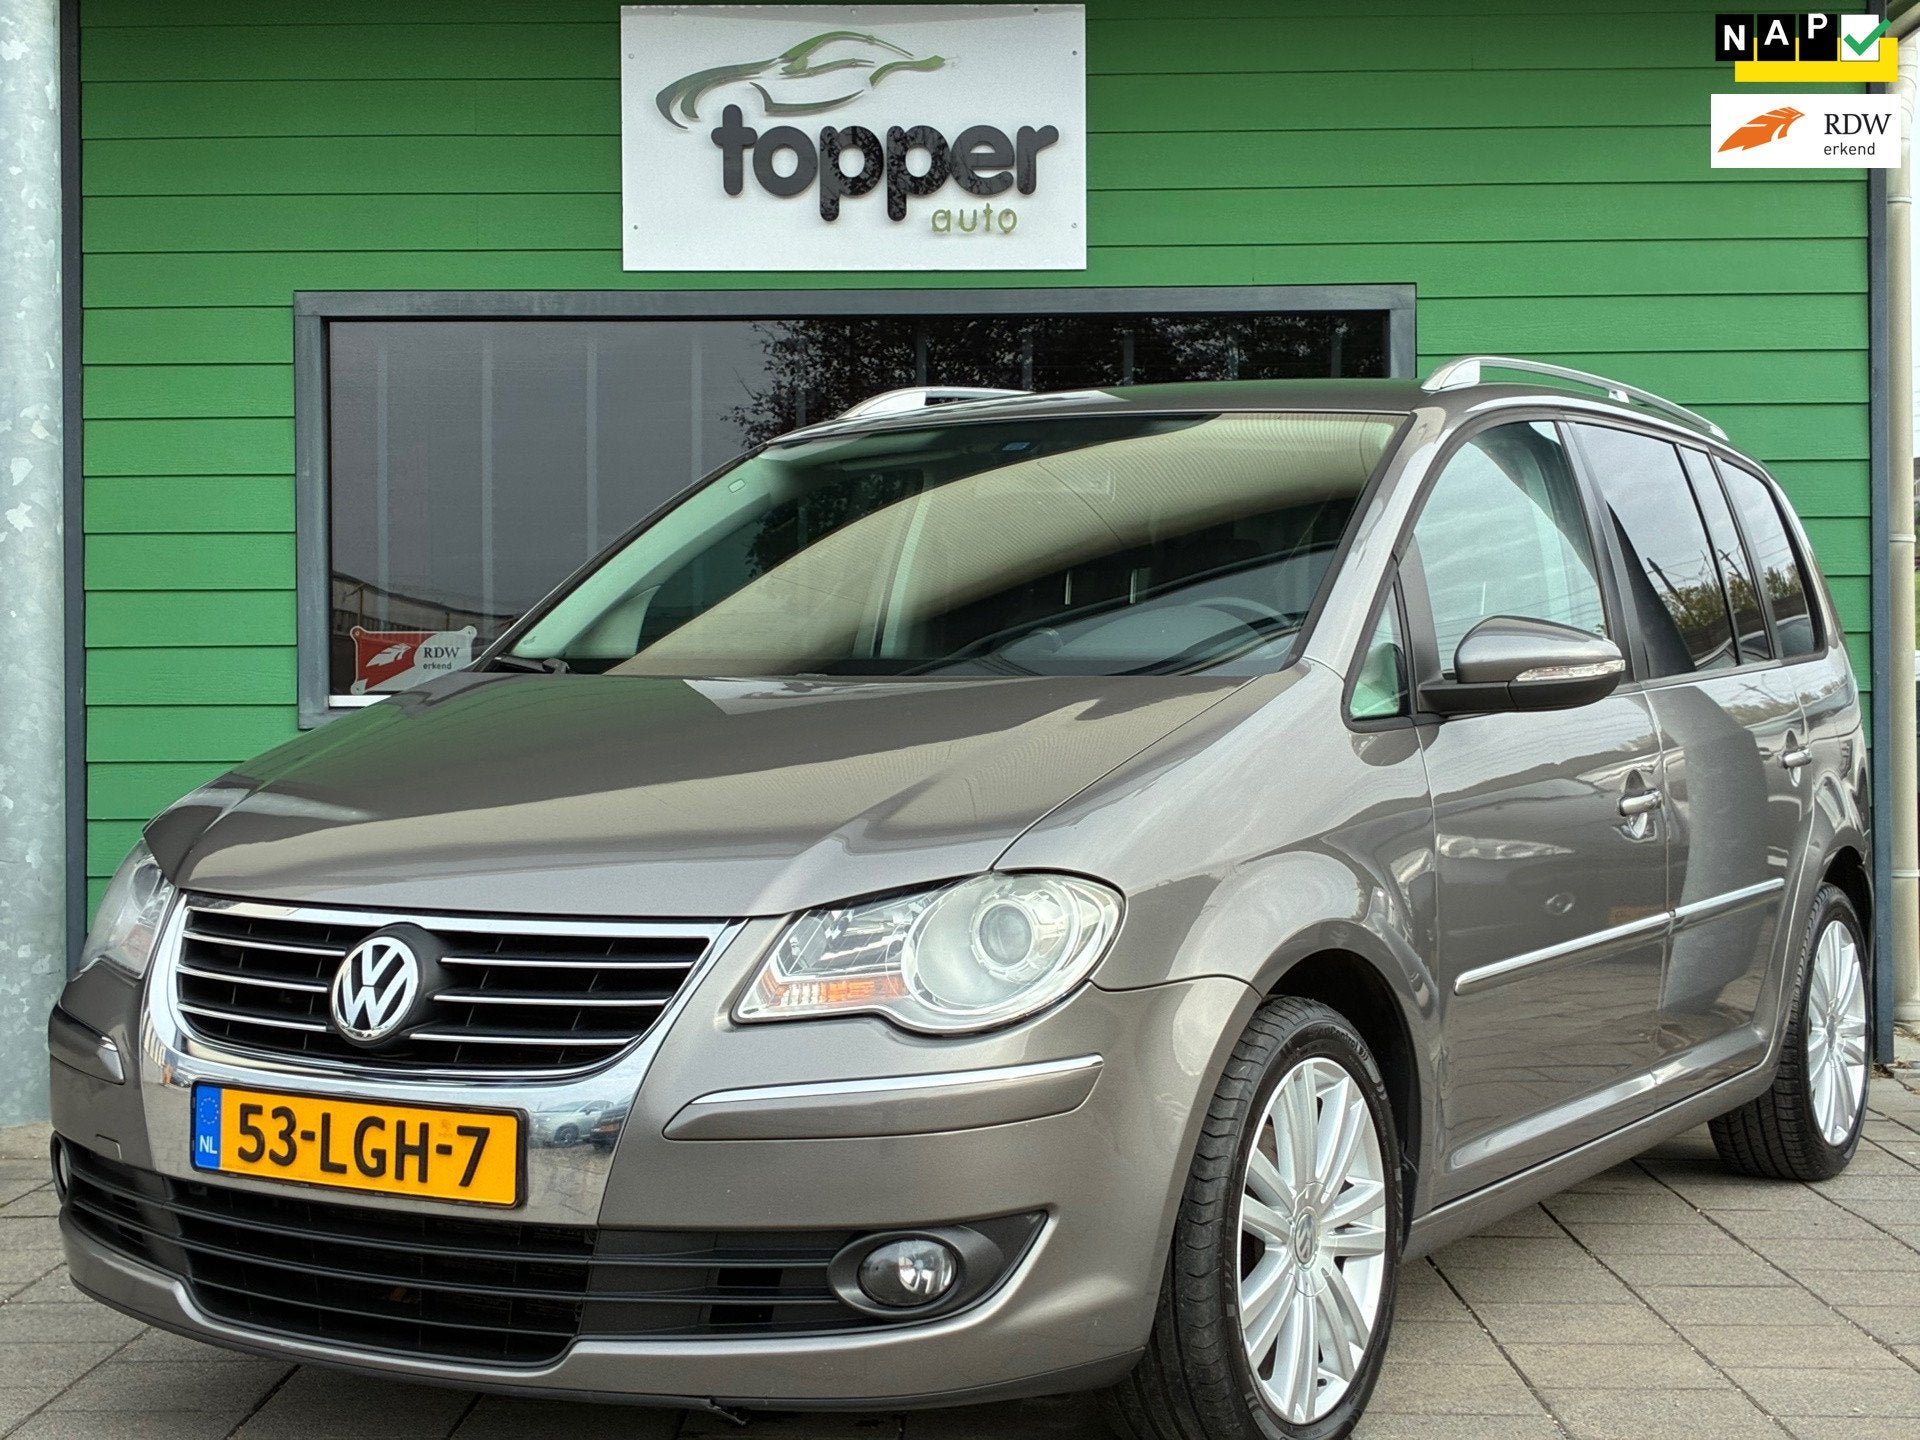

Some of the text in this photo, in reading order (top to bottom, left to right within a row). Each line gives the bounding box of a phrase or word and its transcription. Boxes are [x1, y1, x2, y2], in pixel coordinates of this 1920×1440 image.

[711, 104, 1059, 221] topper
[931, 203, 1018, 233] auto
[423, 647, 460, 659] RDW
[423, 661, 452, 670] erkend
[199, 1135, 218, 1155] NL
[237, 1103, 491, 1188] 53-LGH-7
